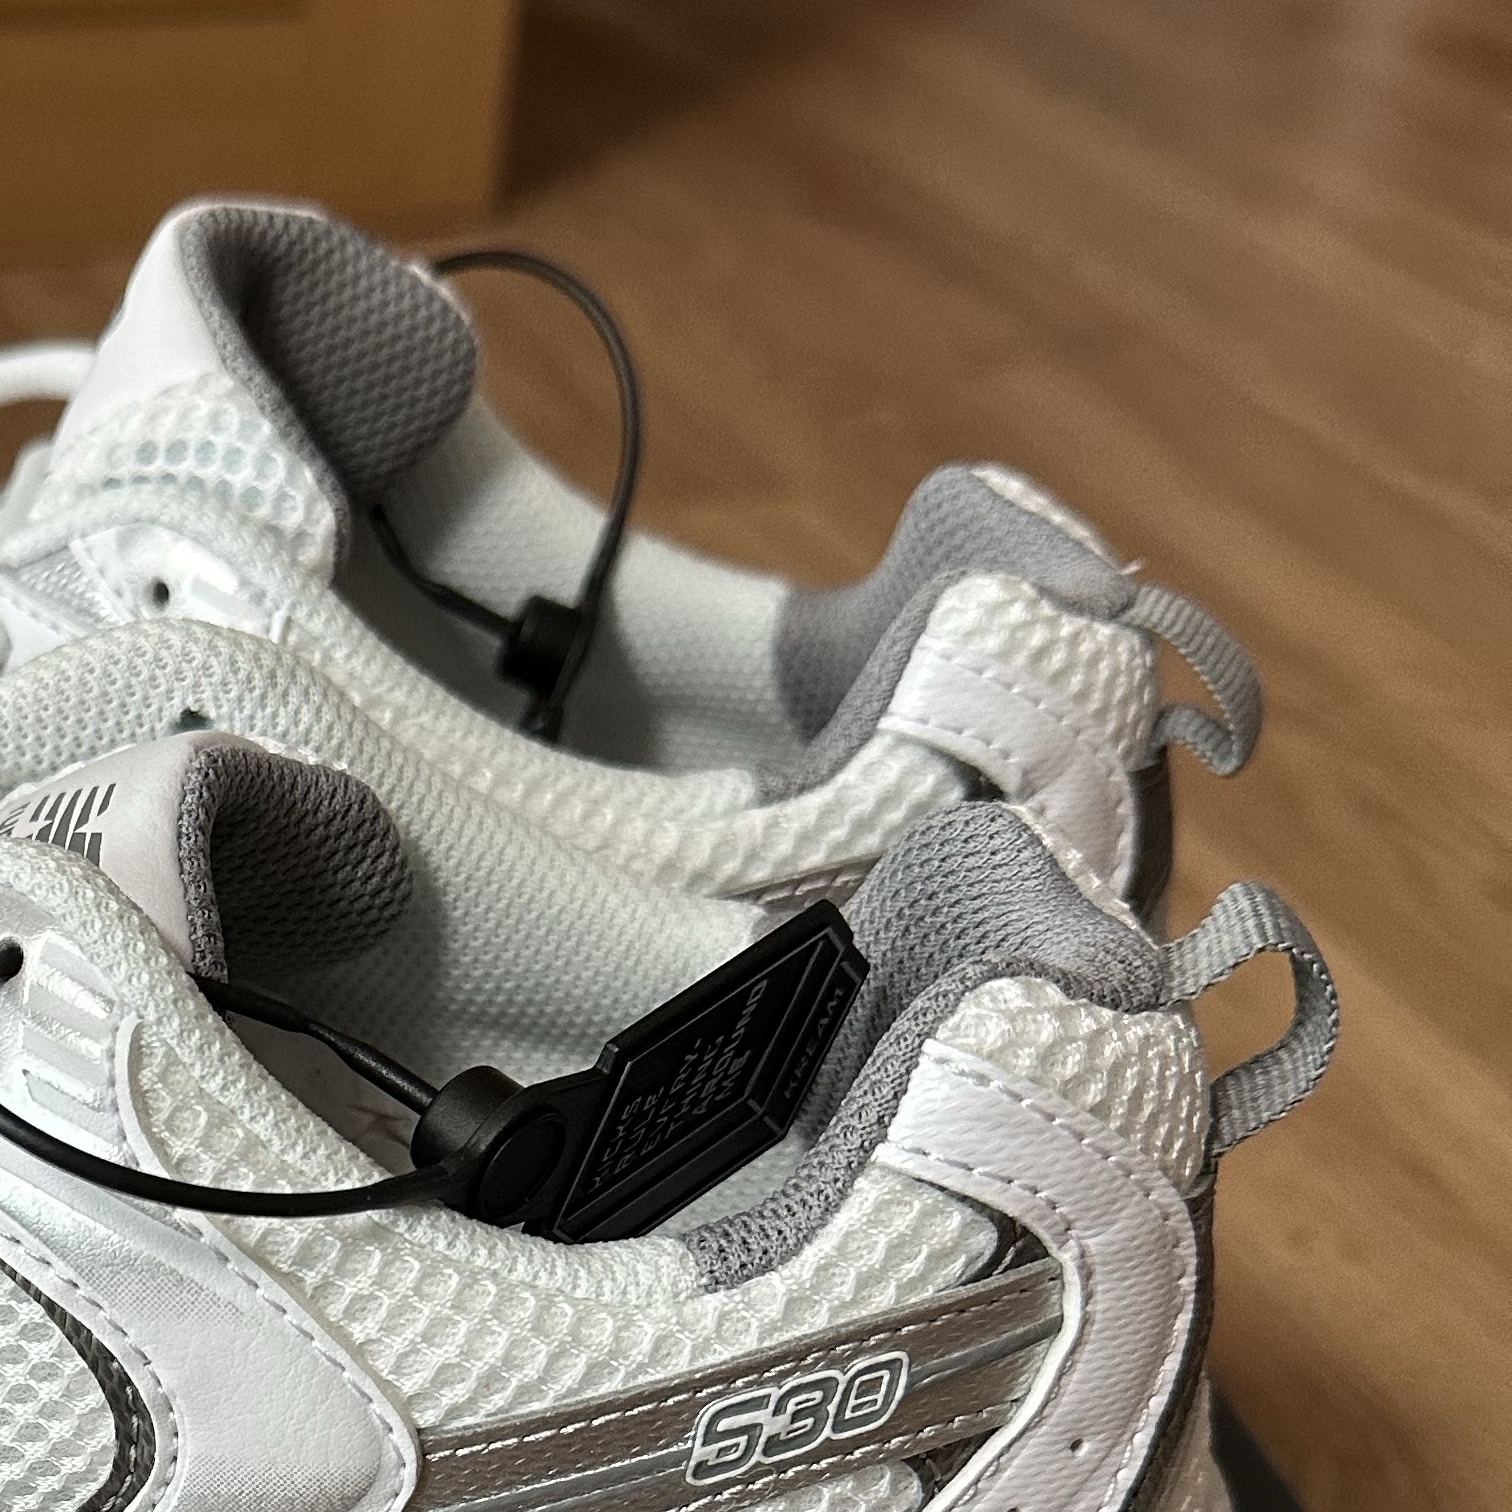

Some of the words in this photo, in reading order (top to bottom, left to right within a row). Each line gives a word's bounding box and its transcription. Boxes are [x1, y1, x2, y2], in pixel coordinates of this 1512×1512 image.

[665, 1035, 725, 1139] THING
[691, 979, 768, 1115] AROUND
[714, 1049, 751, 1102] ME
[784, 988, 844, 1096] KREAM
[613, 1085, 665, 1174] RULE
[686, 1351, 909, 1486] 530
